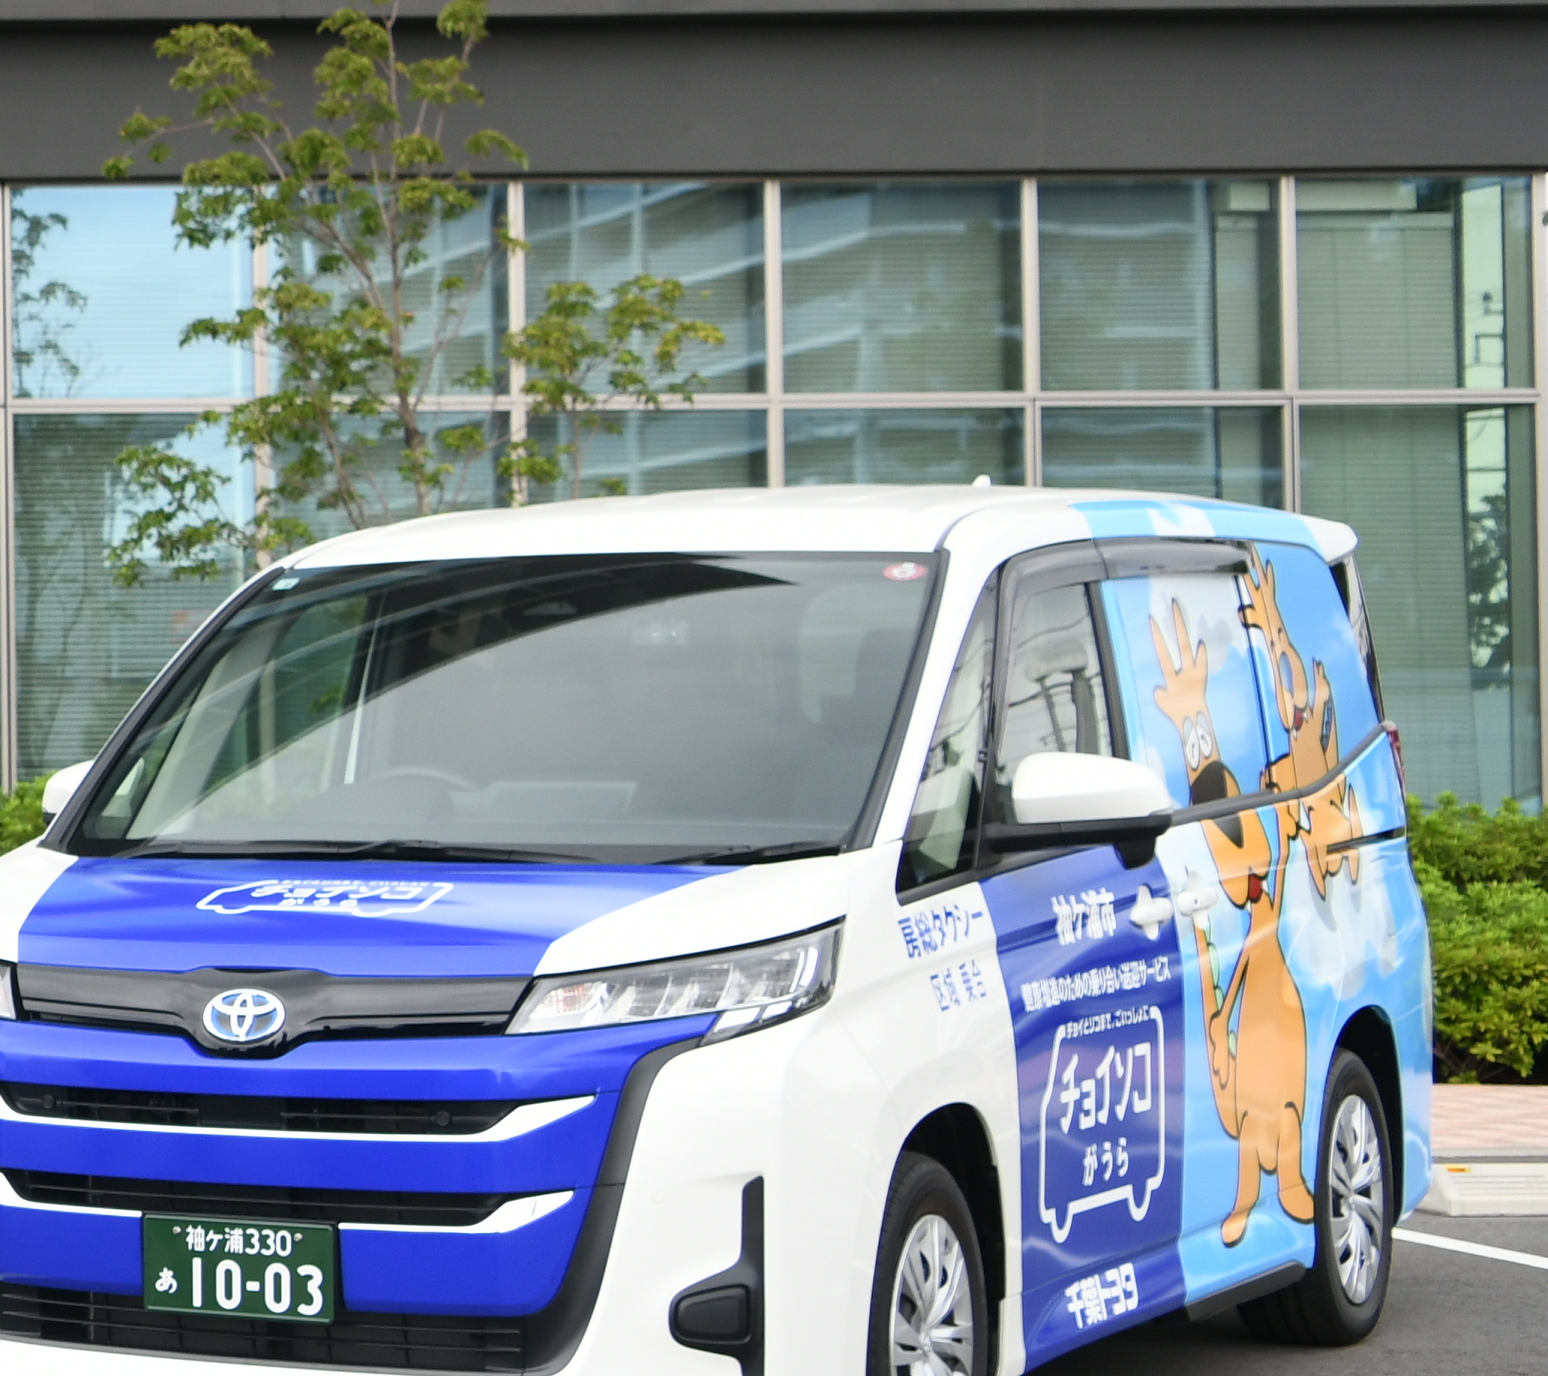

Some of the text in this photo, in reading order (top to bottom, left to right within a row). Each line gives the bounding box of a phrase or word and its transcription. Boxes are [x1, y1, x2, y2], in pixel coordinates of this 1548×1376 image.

[898, 905, 983, 958] 房総タクシー
[1051, 887, 1115, 947] 袖ケ浦市
[1020, 955, 1171, 1012] 健康増進のための乗り合い送迎サービス
[1060, 1044, 1152, 1135] チョイソコ
[1082, 1136, 1129, 1187] がうら
[155, 1256, 324, 1316] あ 10-03
[1066, 1260, 1138, 1327] 千葉トヨタ
